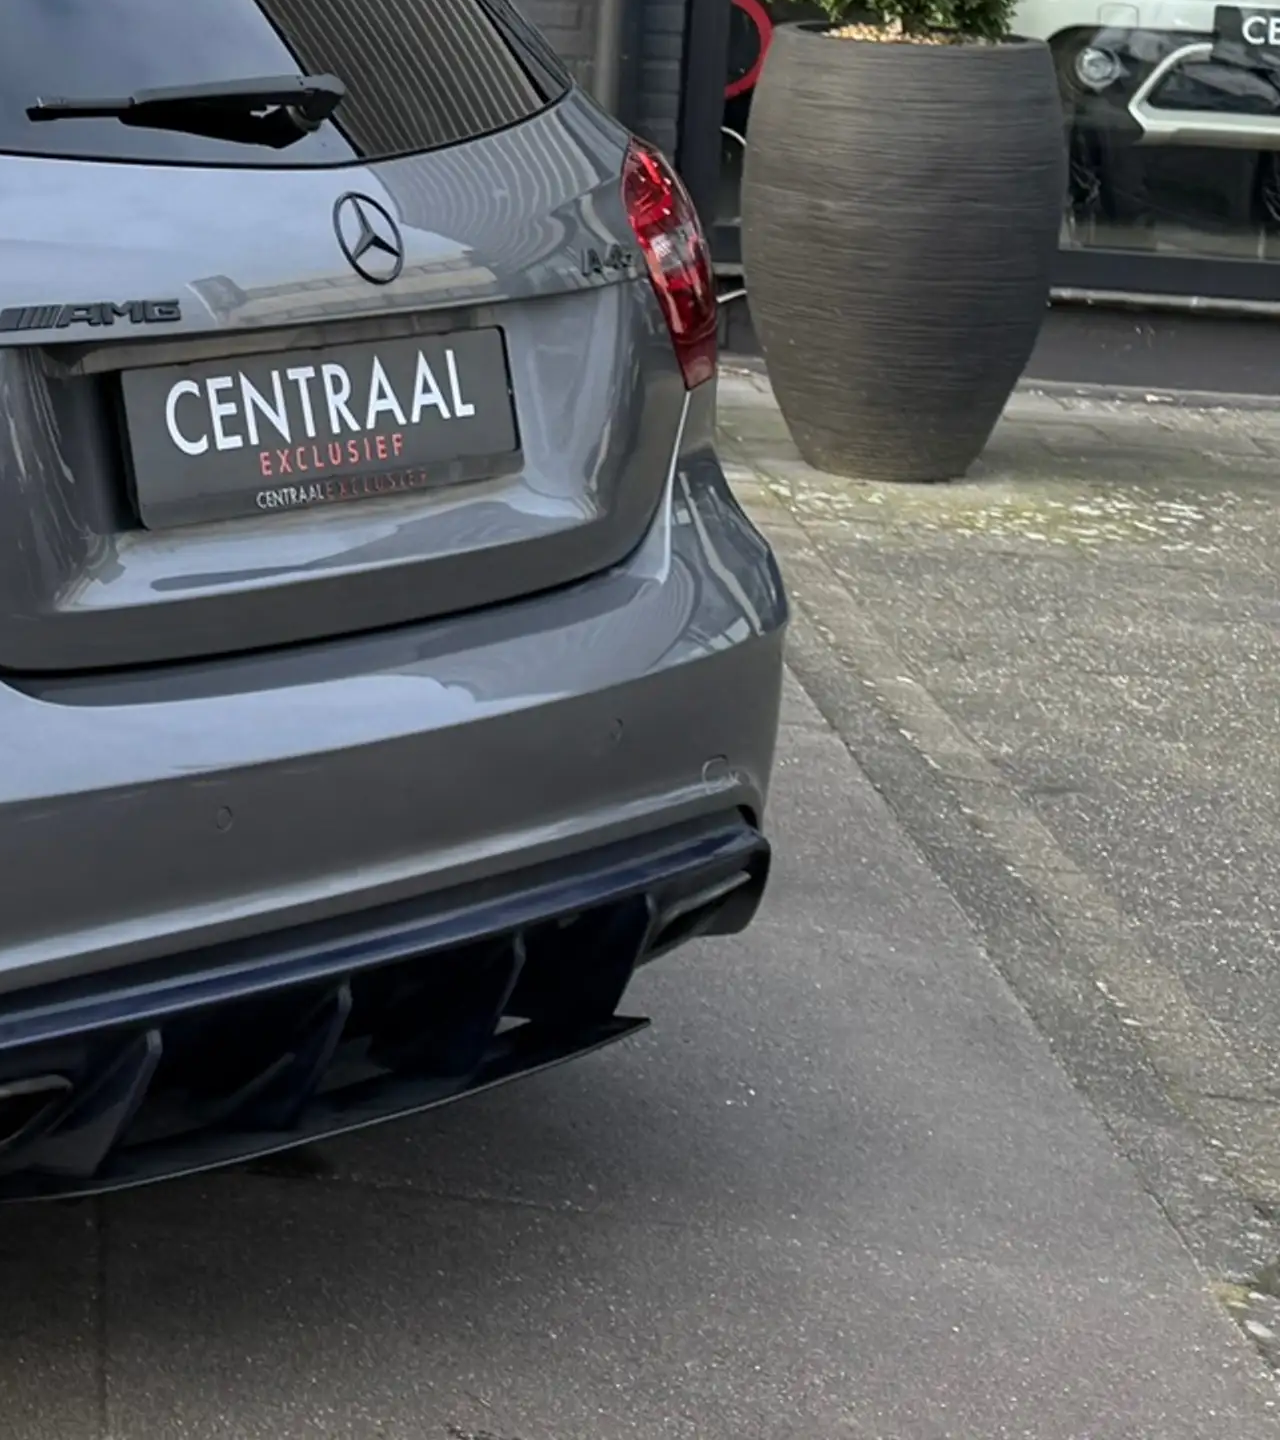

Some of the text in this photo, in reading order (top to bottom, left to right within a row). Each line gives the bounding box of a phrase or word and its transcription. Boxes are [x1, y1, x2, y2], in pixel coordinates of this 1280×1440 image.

[54, 298, 181, 329] AMG
[165, 348, 476, 456] CENTRAAL
[258, 432, 404, 477] EXCLUSIEF
[255, 468, 428, 509] CENTRAAL EXCLUSIEF
